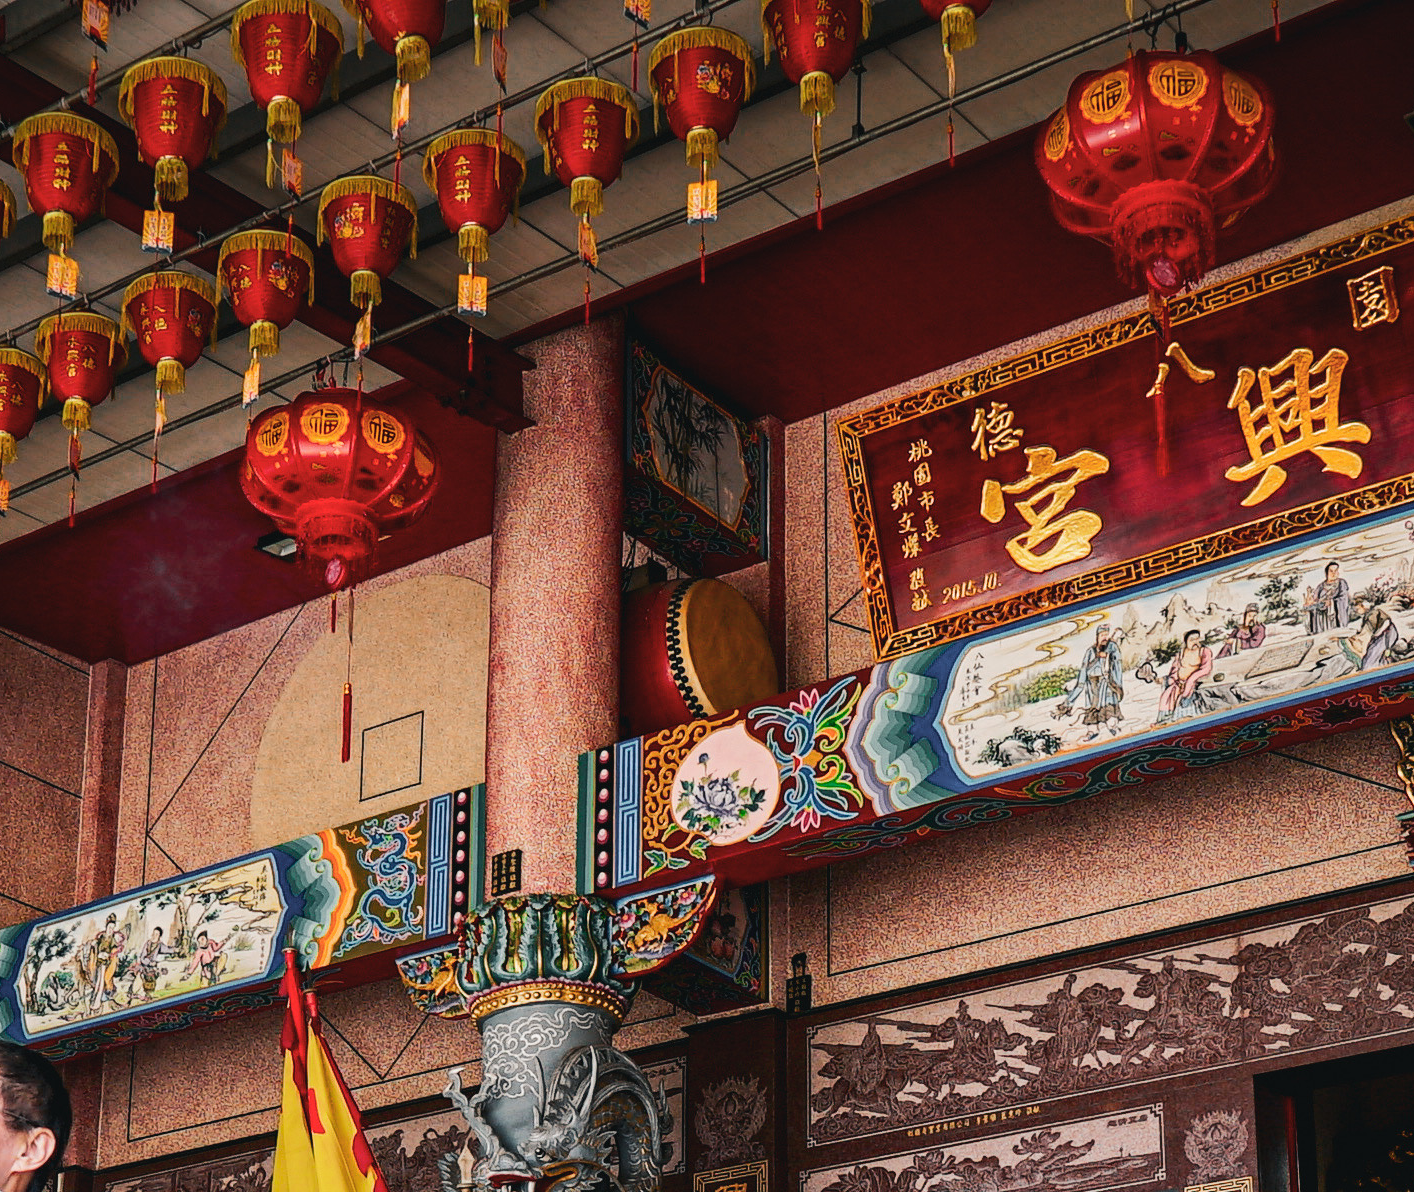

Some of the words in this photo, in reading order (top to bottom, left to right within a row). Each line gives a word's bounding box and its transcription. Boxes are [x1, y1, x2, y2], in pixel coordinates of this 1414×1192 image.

[891, 481, 922, 559] 鄭文燦
[908, 439, 941, 542] 桃園市長
